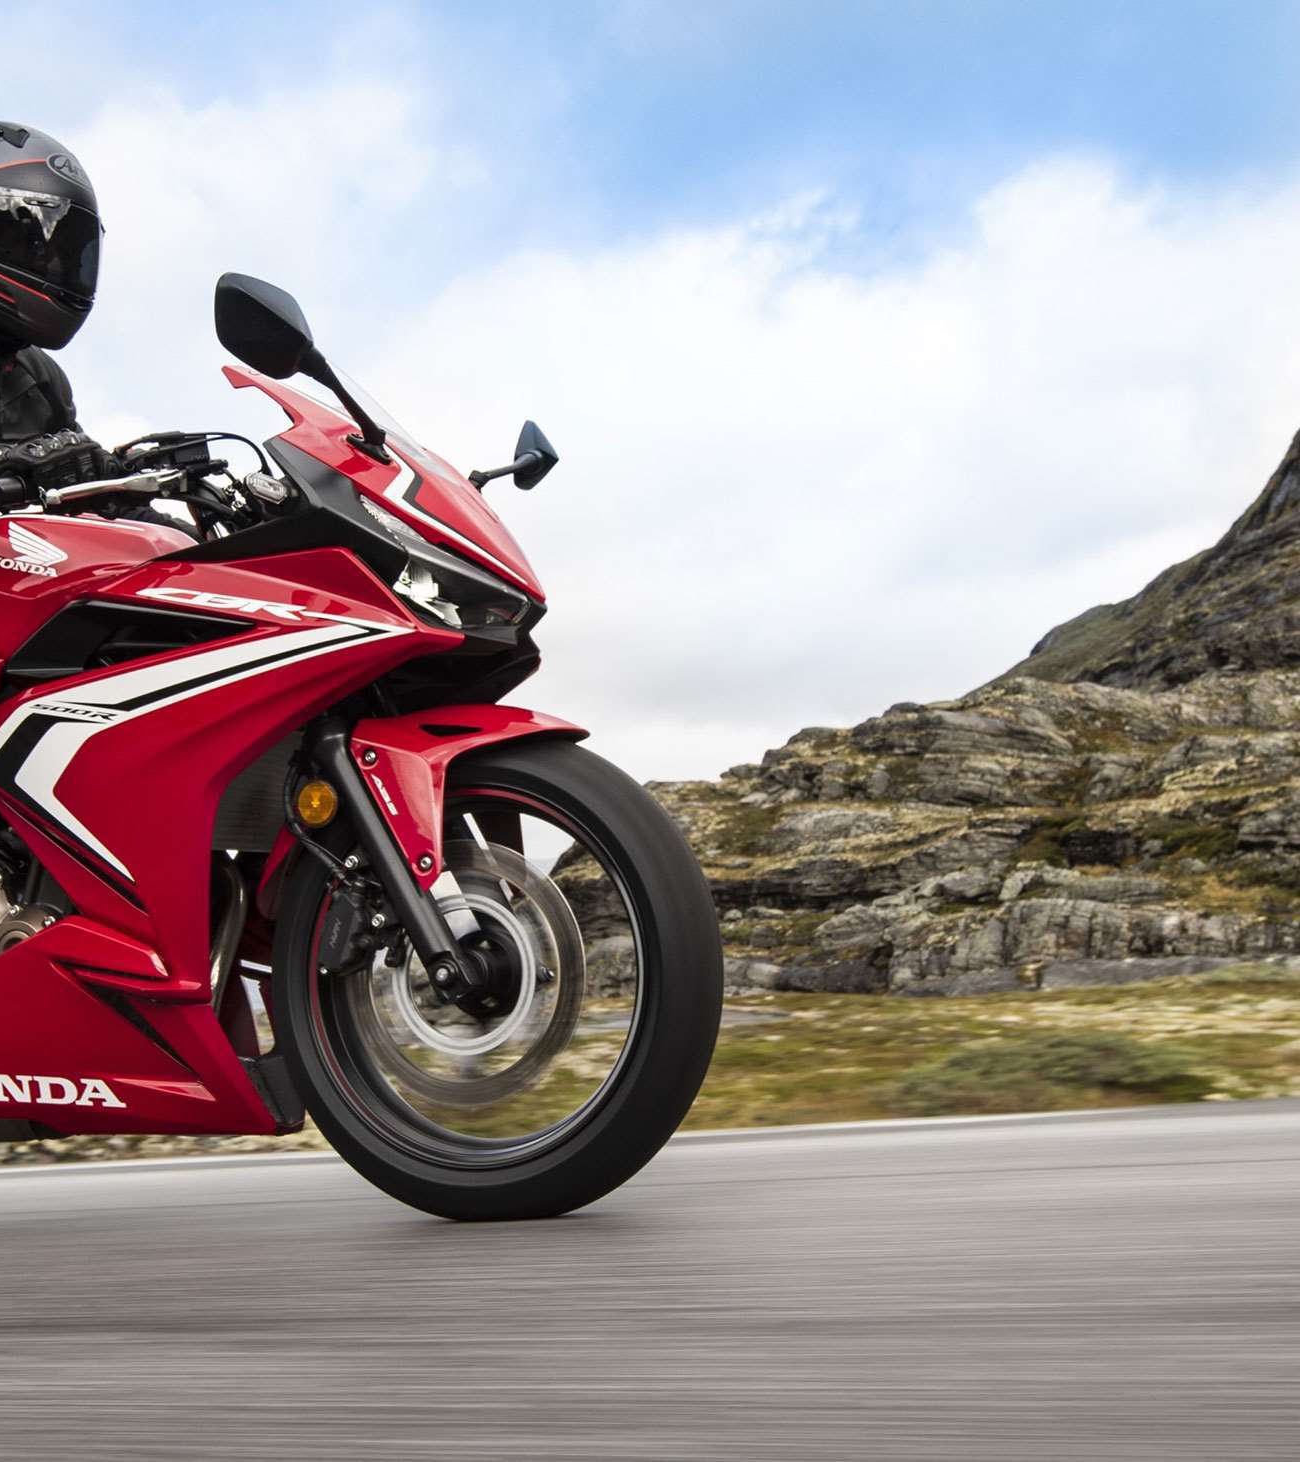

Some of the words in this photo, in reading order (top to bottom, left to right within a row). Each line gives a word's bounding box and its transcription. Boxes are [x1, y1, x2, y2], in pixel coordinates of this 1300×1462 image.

[135, 587, 307, 621] CBR
[29, 703, 118, 721] 500R
[371, 773, 399, 816] ABS
